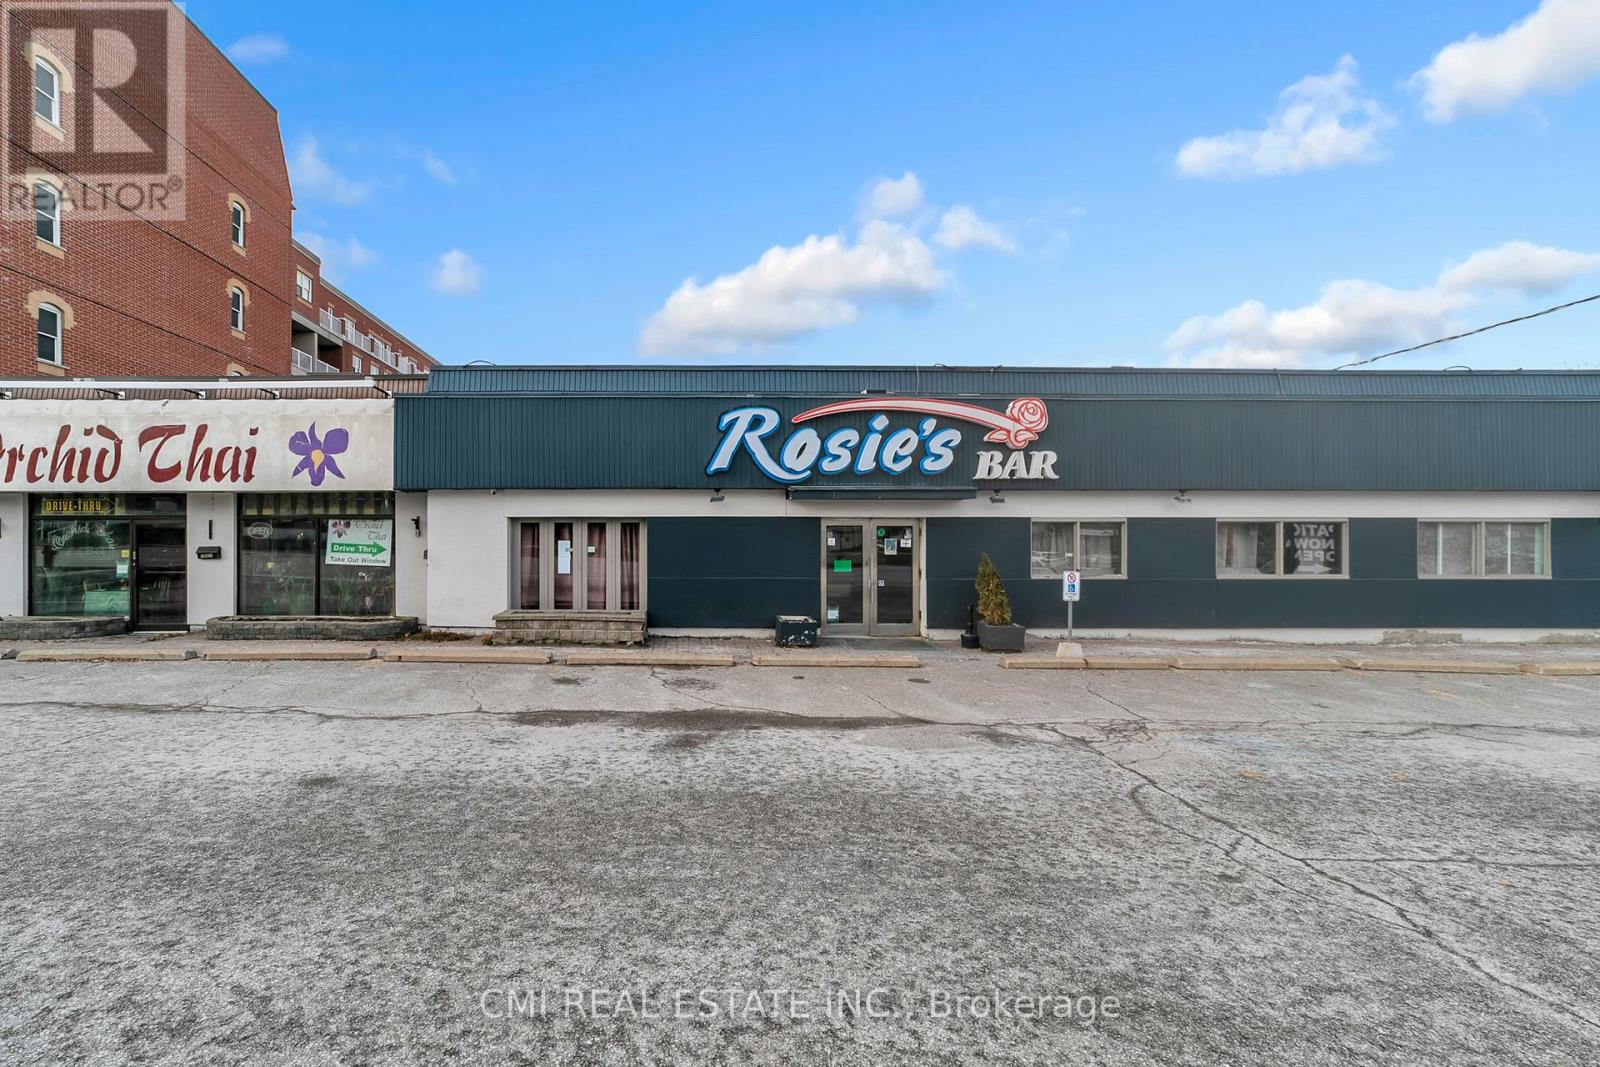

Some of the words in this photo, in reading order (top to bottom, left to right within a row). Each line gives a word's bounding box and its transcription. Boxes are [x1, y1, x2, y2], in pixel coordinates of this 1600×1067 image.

[0, 424, 123, 484] rchid
[138, 423, 259, 484] Thai
[705, 405, 962, 484] Rosie's
[972, 450, 1060, 480] BAR
[46, 500, 101, 511] DRIVE-THRU
[333, 544, 356, 552] Drive
[359, 545, 377, 553] Thru
